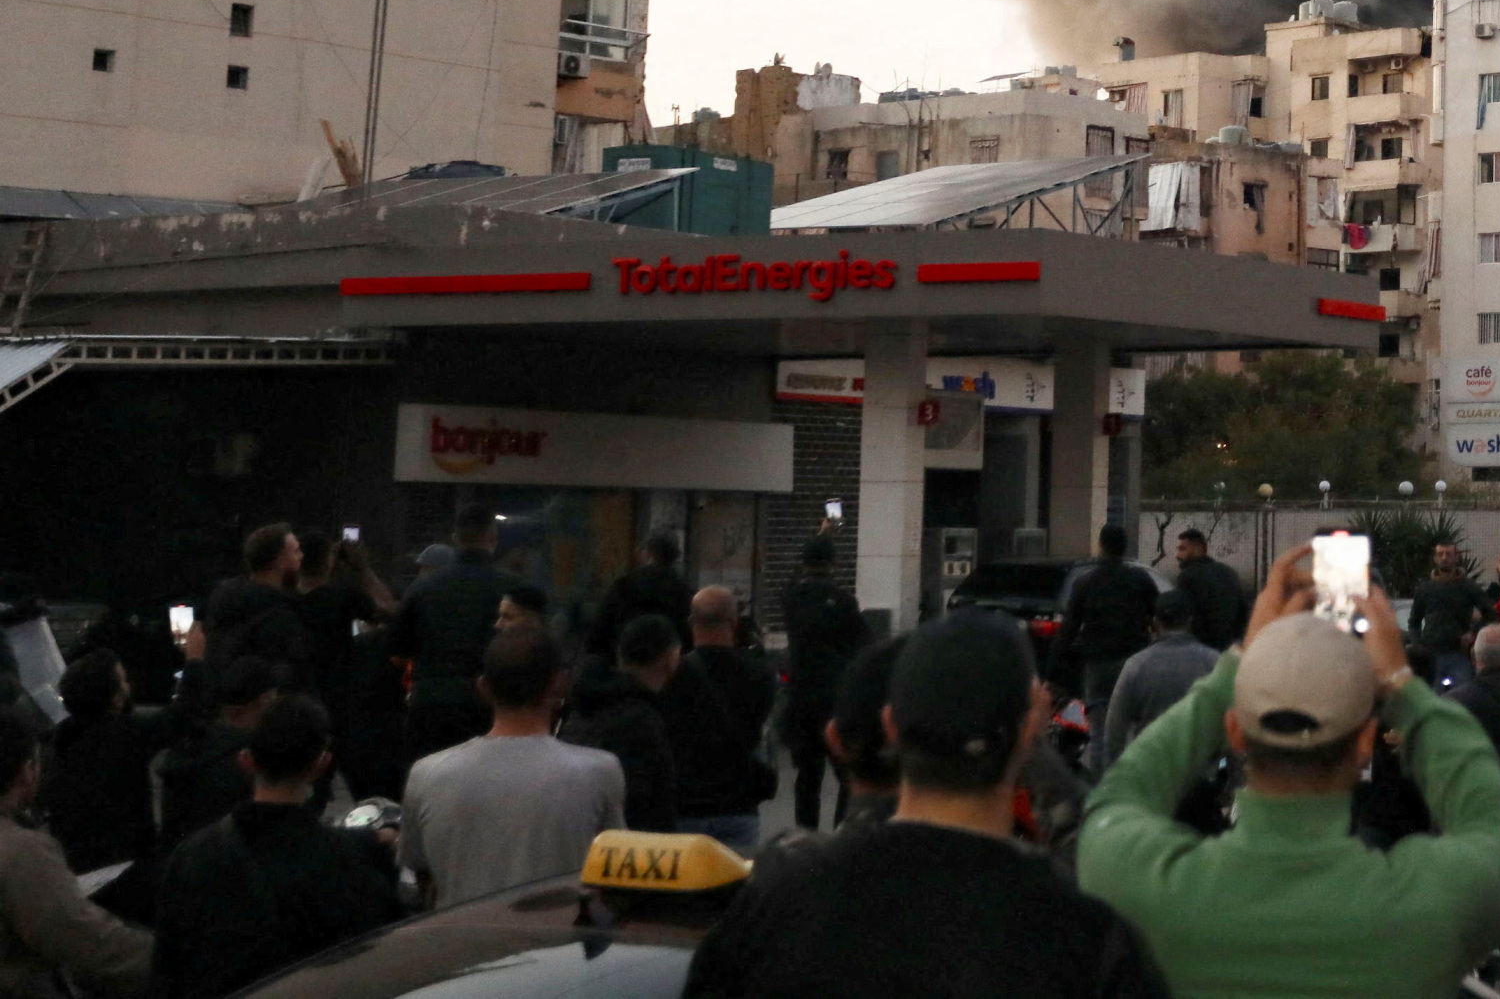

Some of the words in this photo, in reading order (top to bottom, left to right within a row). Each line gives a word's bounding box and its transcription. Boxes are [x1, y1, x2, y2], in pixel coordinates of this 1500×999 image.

[611, 249, 898, 301] TotalEnergies
[1465, 366, 1492, 378] café
[1466, 379, 1491, 387] bonjour
[431, 414, 549, 466] bonjour
[600, 846, 684, 880] TAXI
